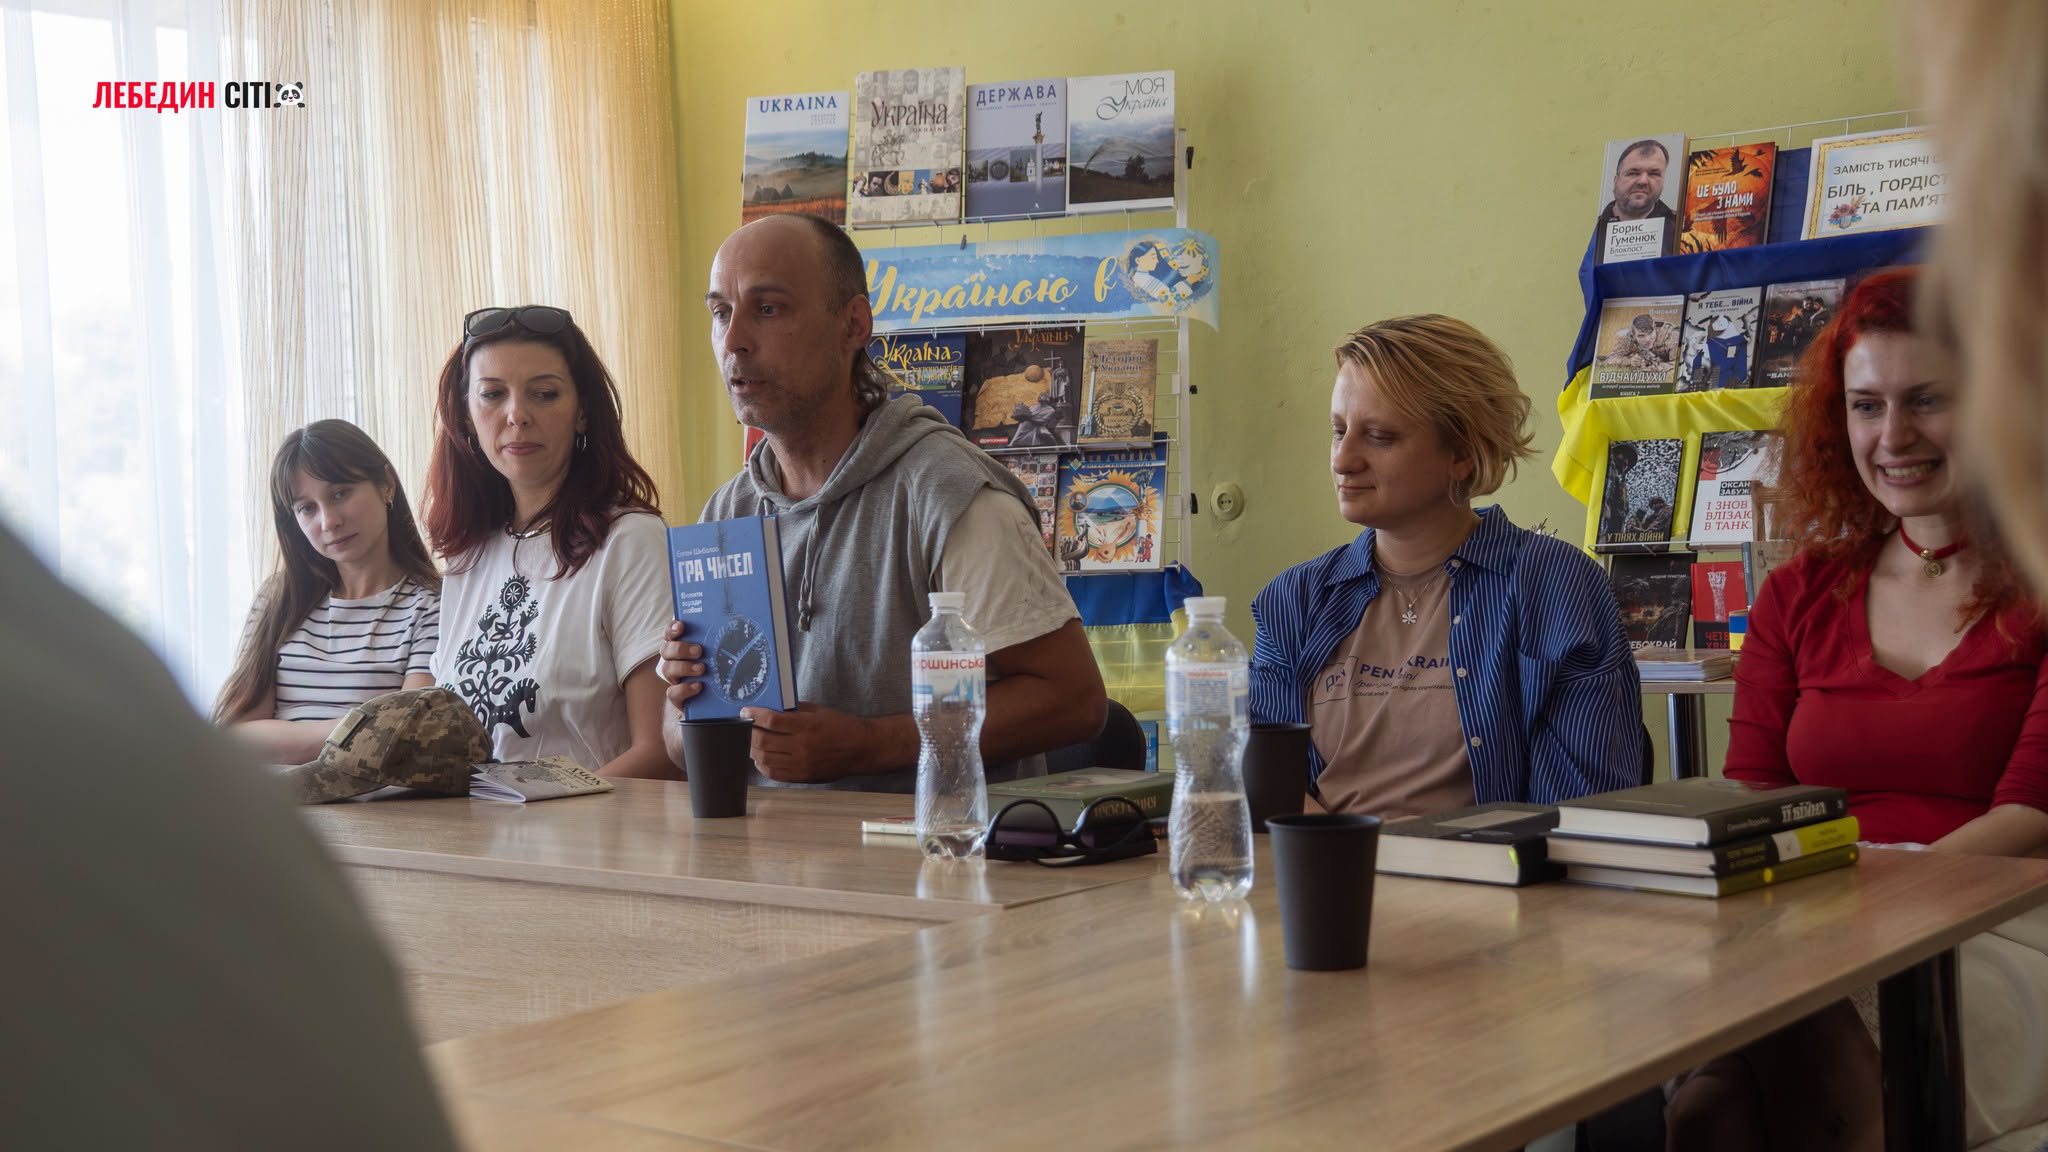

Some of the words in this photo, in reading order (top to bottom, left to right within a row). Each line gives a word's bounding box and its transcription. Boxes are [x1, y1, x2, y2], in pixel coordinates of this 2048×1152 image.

[1125, 77, 1165, 96] МОЯ
[976, 84, 1057, 107] ДЕРЖАВА
[760, 96, 837, 113] UKRAINA
[1833, 161, 1885, 175] ЗАМІСТЬ
[1887, 155, 1930, 169] ТИСЯЧІ
[1697, 184, 1710, 198] ЦЕ
[1712, 180, 1738, 196] БУЛО
[1827, 183, 1866, 199] БІЛЬ
[1880, 173, 1949, 193] ГОРДІСТ
[1716, 196, 1724, 209] З
[1725, 192, 1754, 209] НАМИ
[1861, 202, 1881, 214] ТА
[1885, 193, 1950, 212] ПАМ'ЯТ
[1612, 224, 1644, 235] Борис
[1610, 233, 1656, 246] Гуменюк
[866, 258, 1078, 325] Україною
[1599, 370, 1667, 384] ВІДЧАЙДУХИ
[1720, 488, 1750, 496] ЗАБУЖ
[1721, 481, 1751, 489] ОКСАН
[1715, 500, 1748, 510] ЗНОВ
[1704, 521, 1712, 531] В
[1614, 533, 1637, 542] ТІНЯХ
[1638, 531, 1665, 542] ВІЙНИ
[678, 558, 704, 584] ГРА
[706, 552, 754, 580] ЧИСЕЛ
[1628, 638, 1678, 649] ЕБОКРАЙ
[1705, 631, 1730, 641] ЧЕТВ
[1359, 664, 1395, 679] PEN
